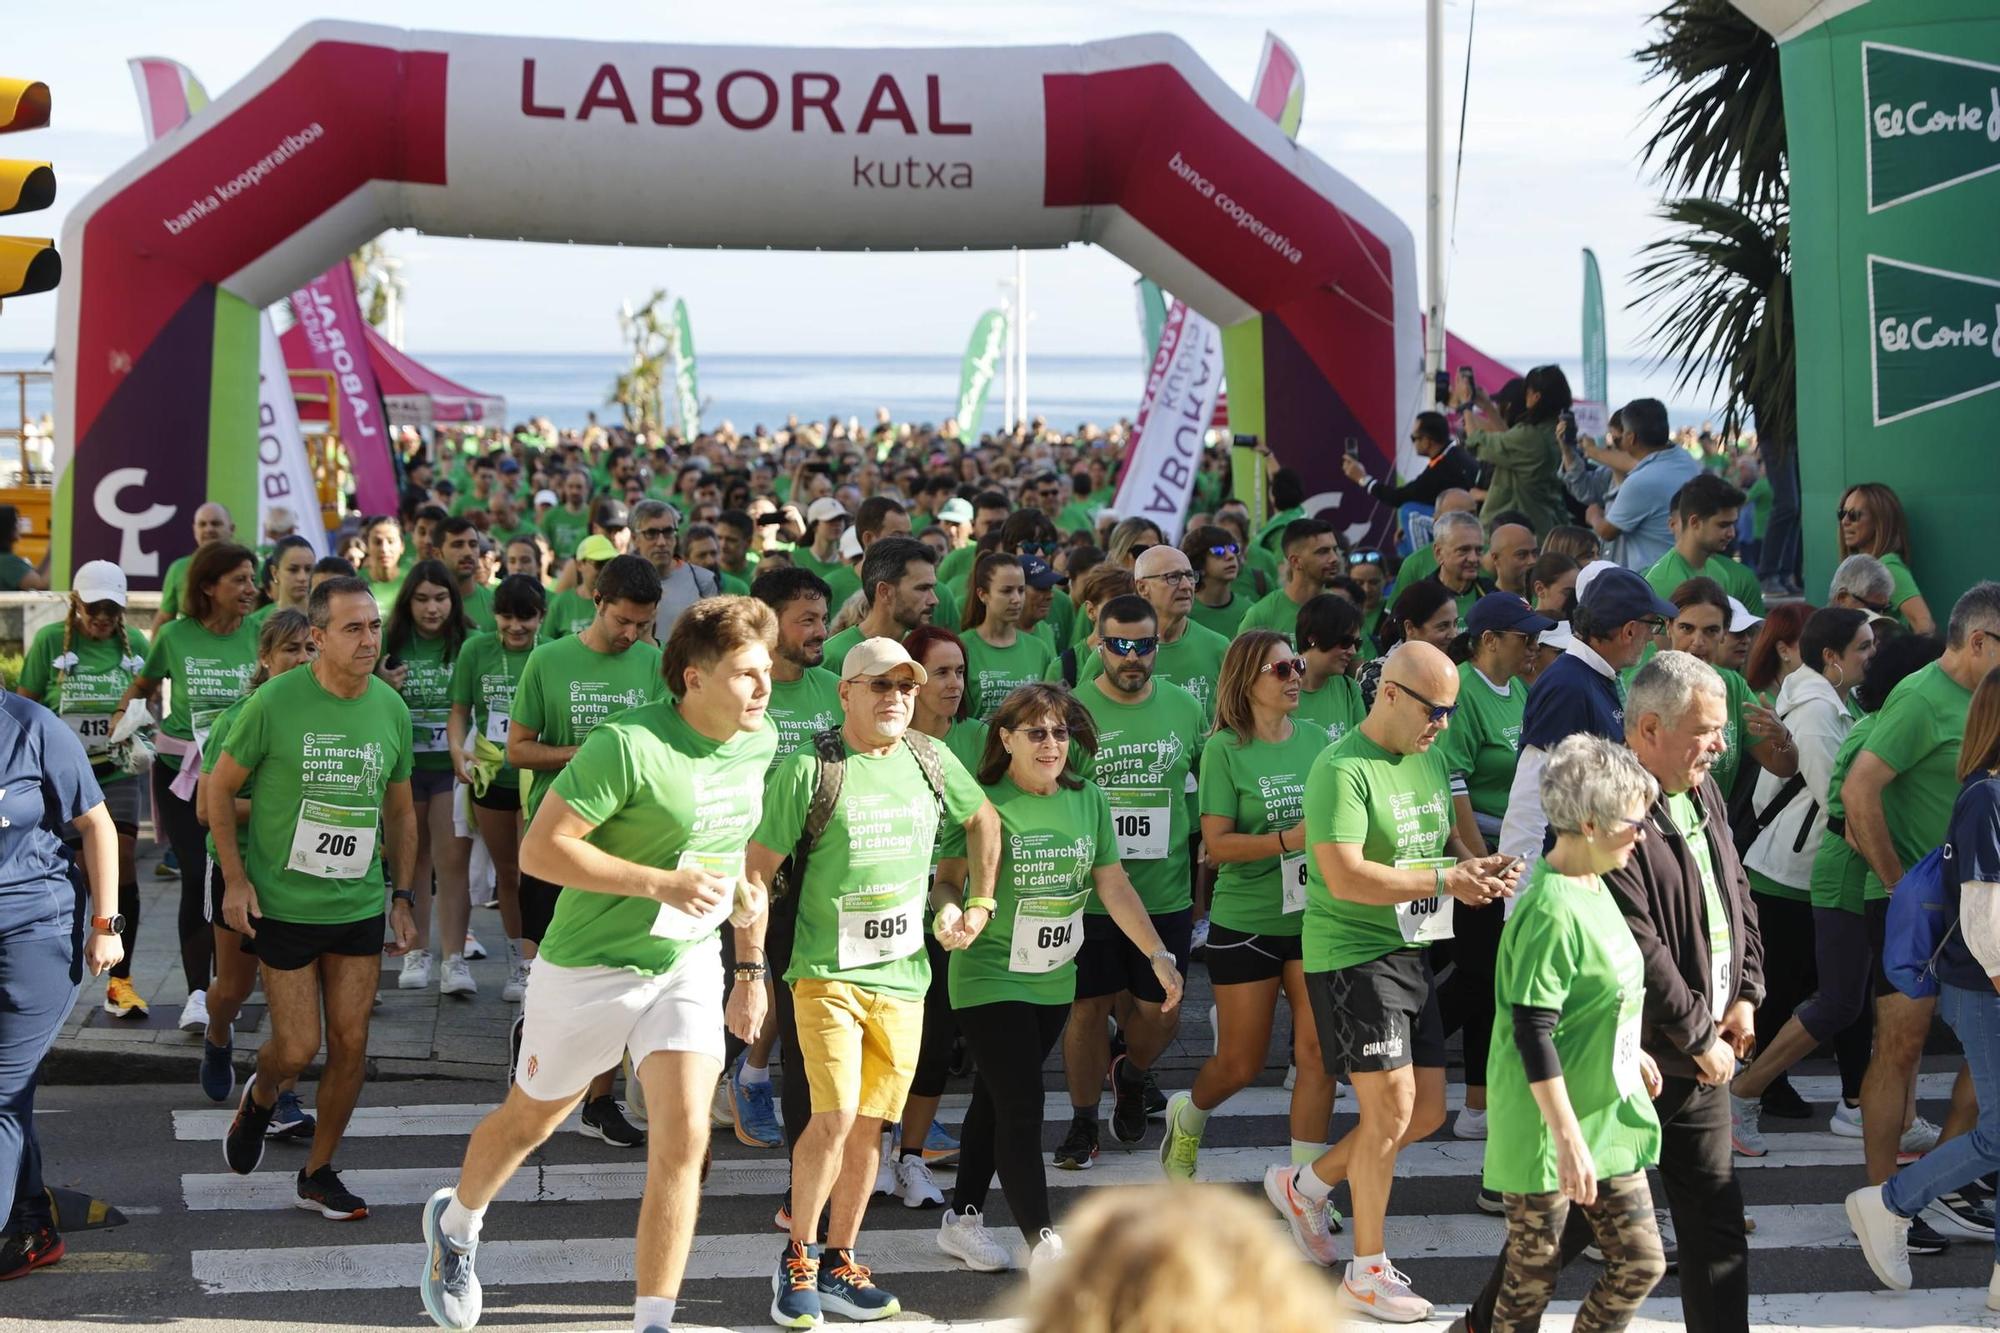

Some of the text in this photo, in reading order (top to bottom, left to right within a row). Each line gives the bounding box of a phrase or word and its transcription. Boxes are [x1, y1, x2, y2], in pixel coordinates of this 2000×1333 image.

[521, 58, 972, 135] LABORAL
[1906, 101, 1983, 135] Corte
[163, 122, 324, 235] banka kooperatiboa
[853, 156, 973, 189] kutxa
[1168, 152, 1303, 264] banca cooperativa
[1911, 316, 1987, 350] Corte
[186, 666, 200, 675] En
[187, 677, 222, 686] contra
[482, 684, 494, 693] En
[981, 680, 994, 689] En
[188, 686, 197, 695] el
[570, 692, 633, 705] En marcha
[571, 703, 608, 714] contra
[500, 719, 508, 733] 1
[571, 714, 582, 724] el
[780, 720, 822, 730] marcha
[80, 720, 109, 736] 413
[778, 731, 800, 740] ntra
[303, 746, 372, 760] En marcha
[1094, 740, 1174, 761] En marcha
[302, 760, 343, 770] contra
[1096, 758, 1143, 775] contra
[302, 771, 361, 783] el cáncer
[1097, 770, 1164, 786] el cáncer
[1261, 784, 1304, 798] En mar
[848, 810, 866, 822] En
[1267, 807, 1303, 821] el cán
[849, 824, 892, 836] contra
[1115, 815, 1151, 837] 105
[316, 832, 357, 857] 206
[850, 838, 862, 849] el
[1397, 834, 1408, 847] el
[1012, 845, 1083, 860] En marcha
[1014, 862, 1055, 873] contra
[1014, 873, 1072, 886] el cáncer
[1299, 864, 1308, 886] 8
[864, 913, 908, 940] 695
[1037, 922, 1073, 949] 694
[1720, 963, 1728, 989] 9
